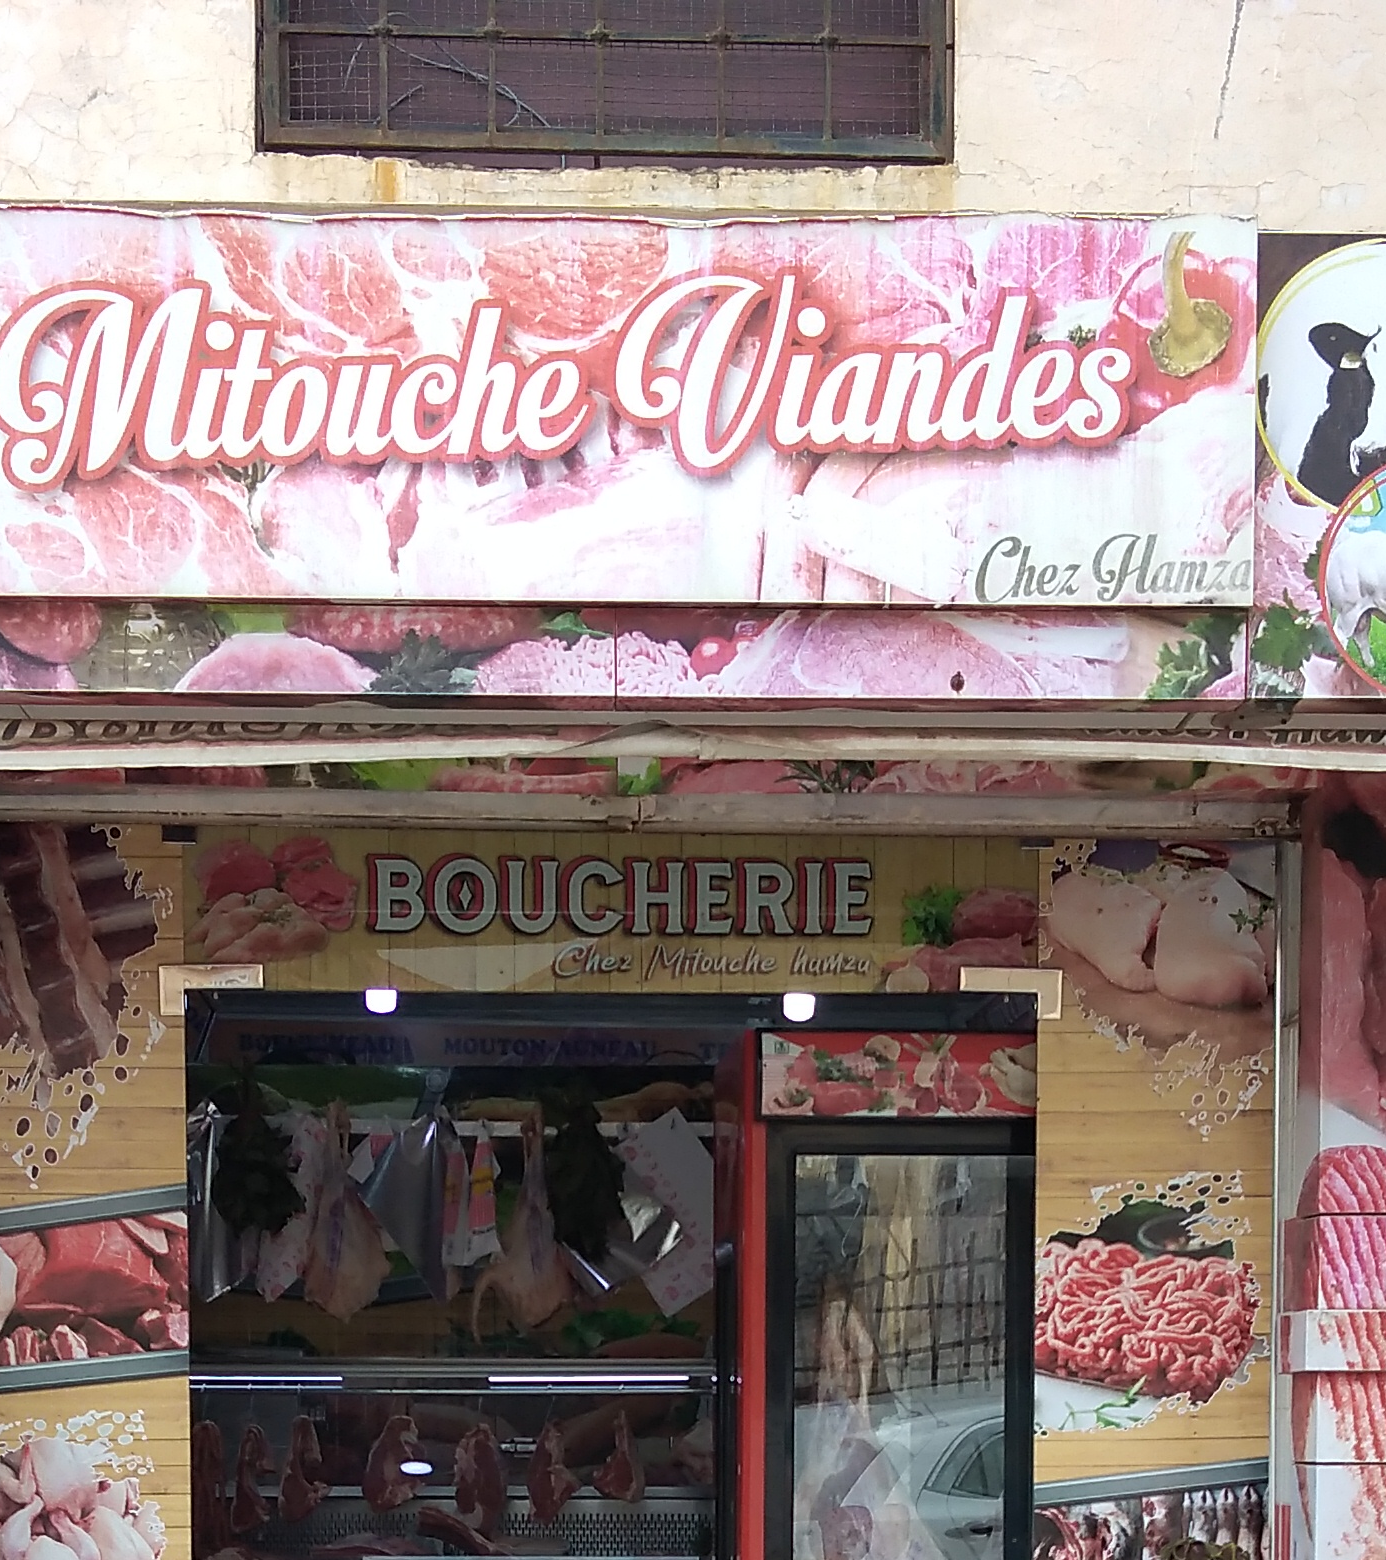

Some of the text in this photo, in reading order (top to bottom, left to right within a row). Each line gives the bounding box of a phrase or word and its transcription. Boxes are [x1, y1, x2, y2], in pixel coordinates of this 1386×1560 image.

[613, 272, 1129, 474] Viandes
[975, 533, 1252, 603] Chez Hamza
[367, 853, 872, 935] BOUCHERIE
[552, 944, 632, 978] Chez
[643, 943, 777, 981] Mitouche
